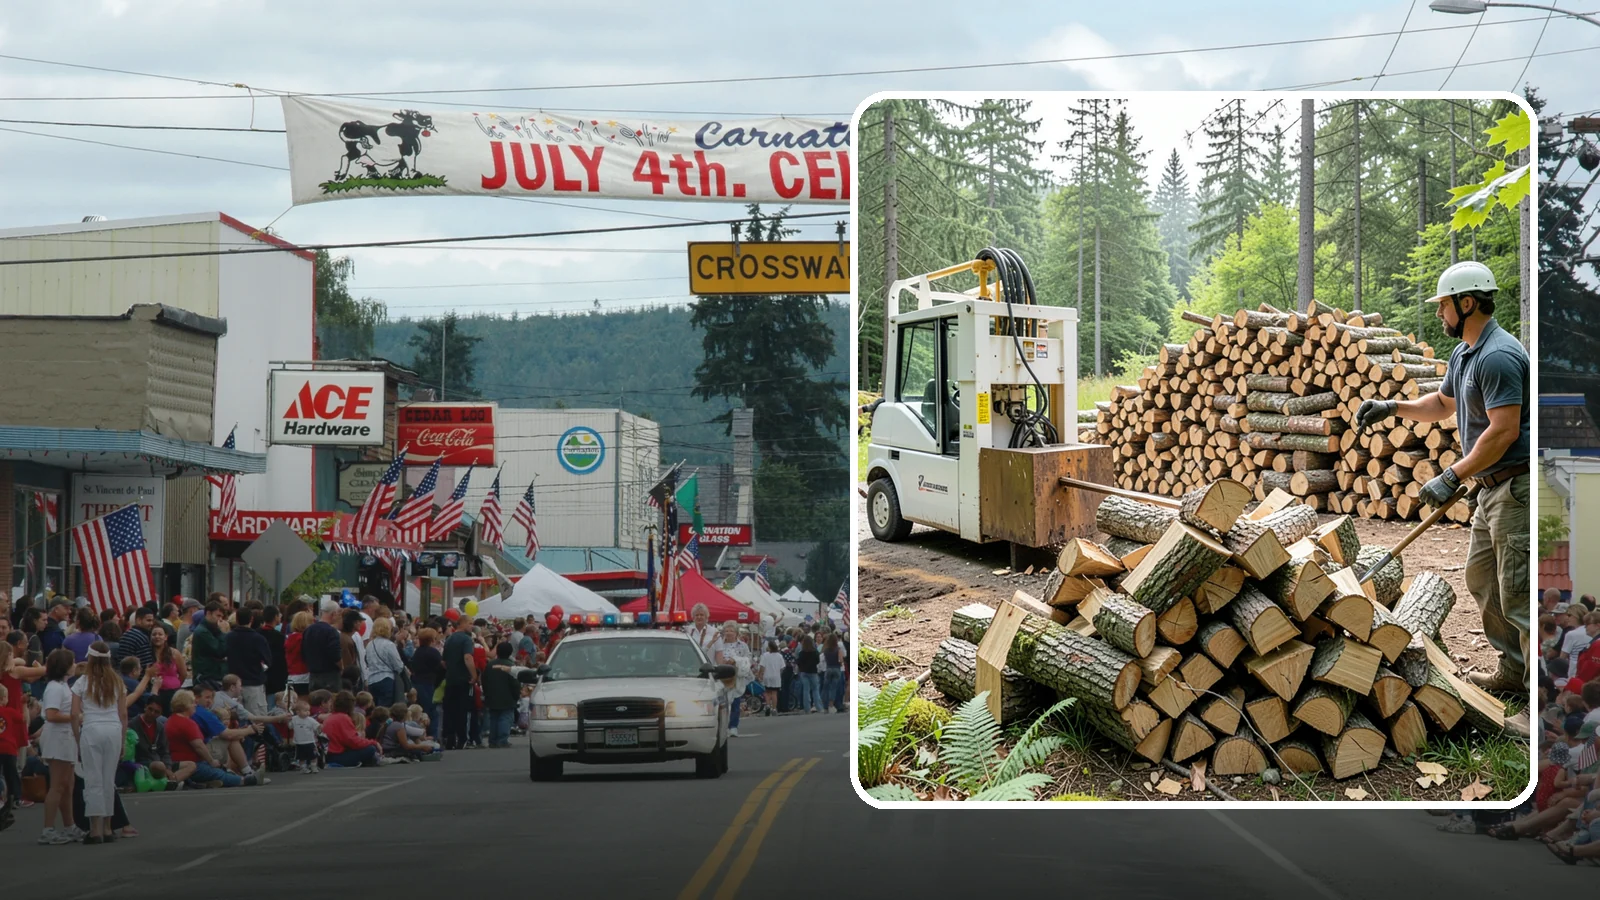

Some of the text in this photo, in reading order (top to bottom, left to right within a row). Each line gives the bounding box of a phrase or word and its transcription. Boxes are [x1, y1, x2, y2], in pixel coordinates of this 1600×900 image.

[481, 141, 605, 192] JULY
[632, 150, 746, 197] 4th.
[697, 254, 850, 280] CROSSWA
[283, 380, 373, 420] ACE
[405, 409, 453, 422] CEDAR
[283, 421, 371, 436] Hardware
[95, 485, 124, 495] Vincent
[126, 486, 136, 495] de
[137, 487, 155, 496] Paul
[688, 526, 741, 534] CRNATION
